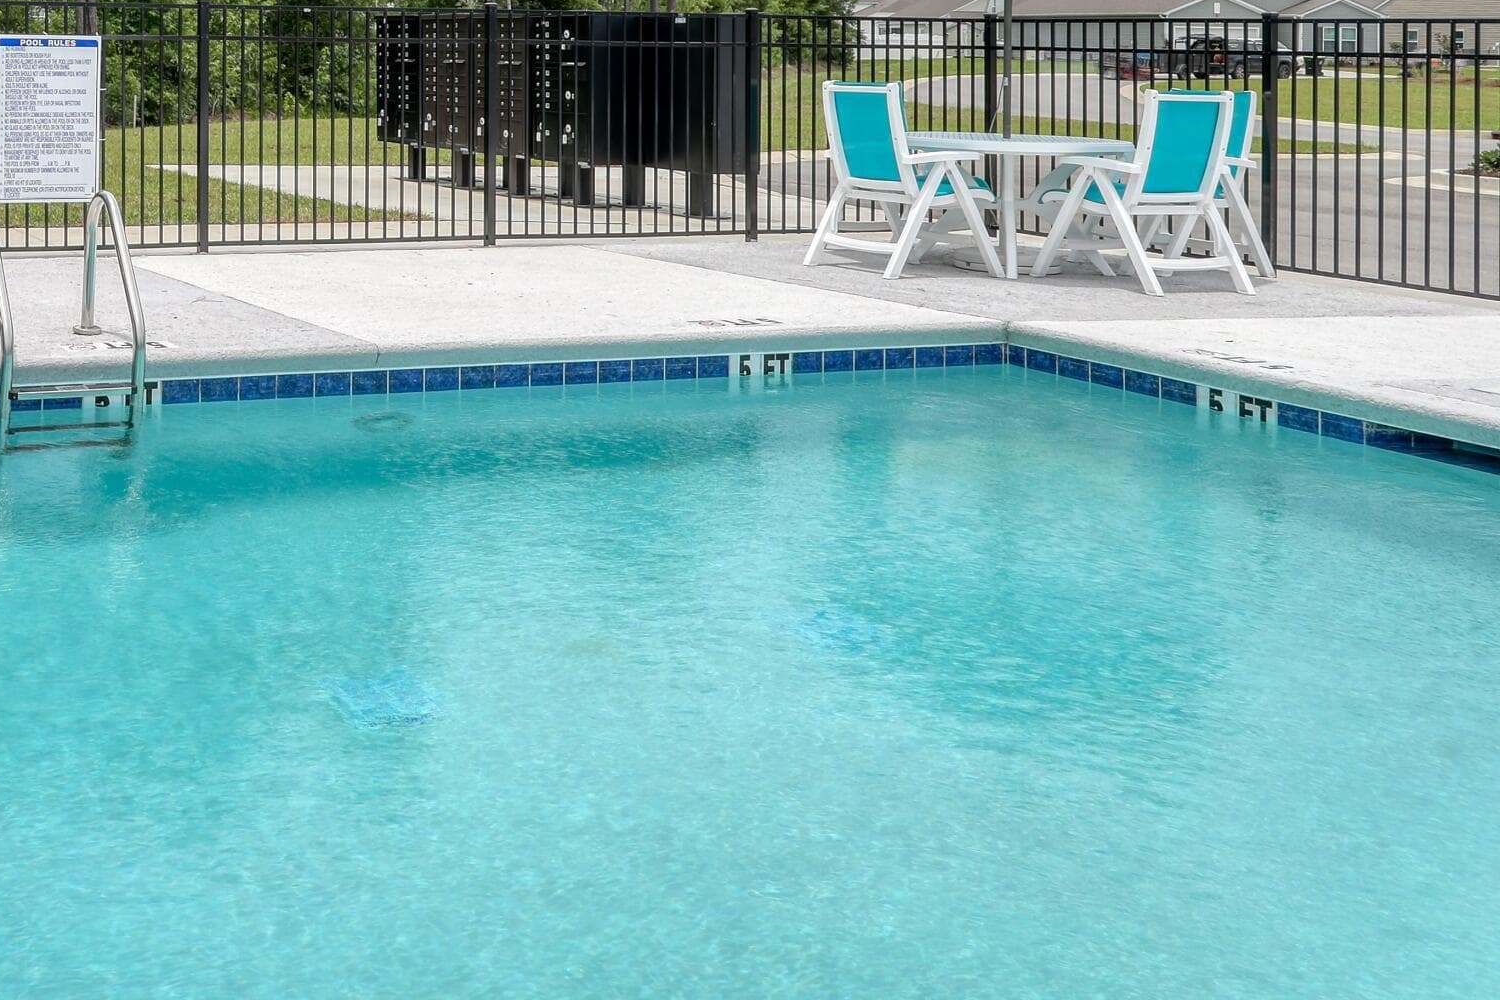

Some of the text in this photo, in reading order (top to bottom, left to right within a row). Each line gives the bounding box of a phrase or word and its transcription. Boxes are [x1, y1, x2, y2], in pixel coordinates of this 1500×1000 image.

[20, 39, 77, 47] POOL RULES
[739, 353, 790, 376] 5 FT
[1209, 387, 1273, 422] 5 FT
